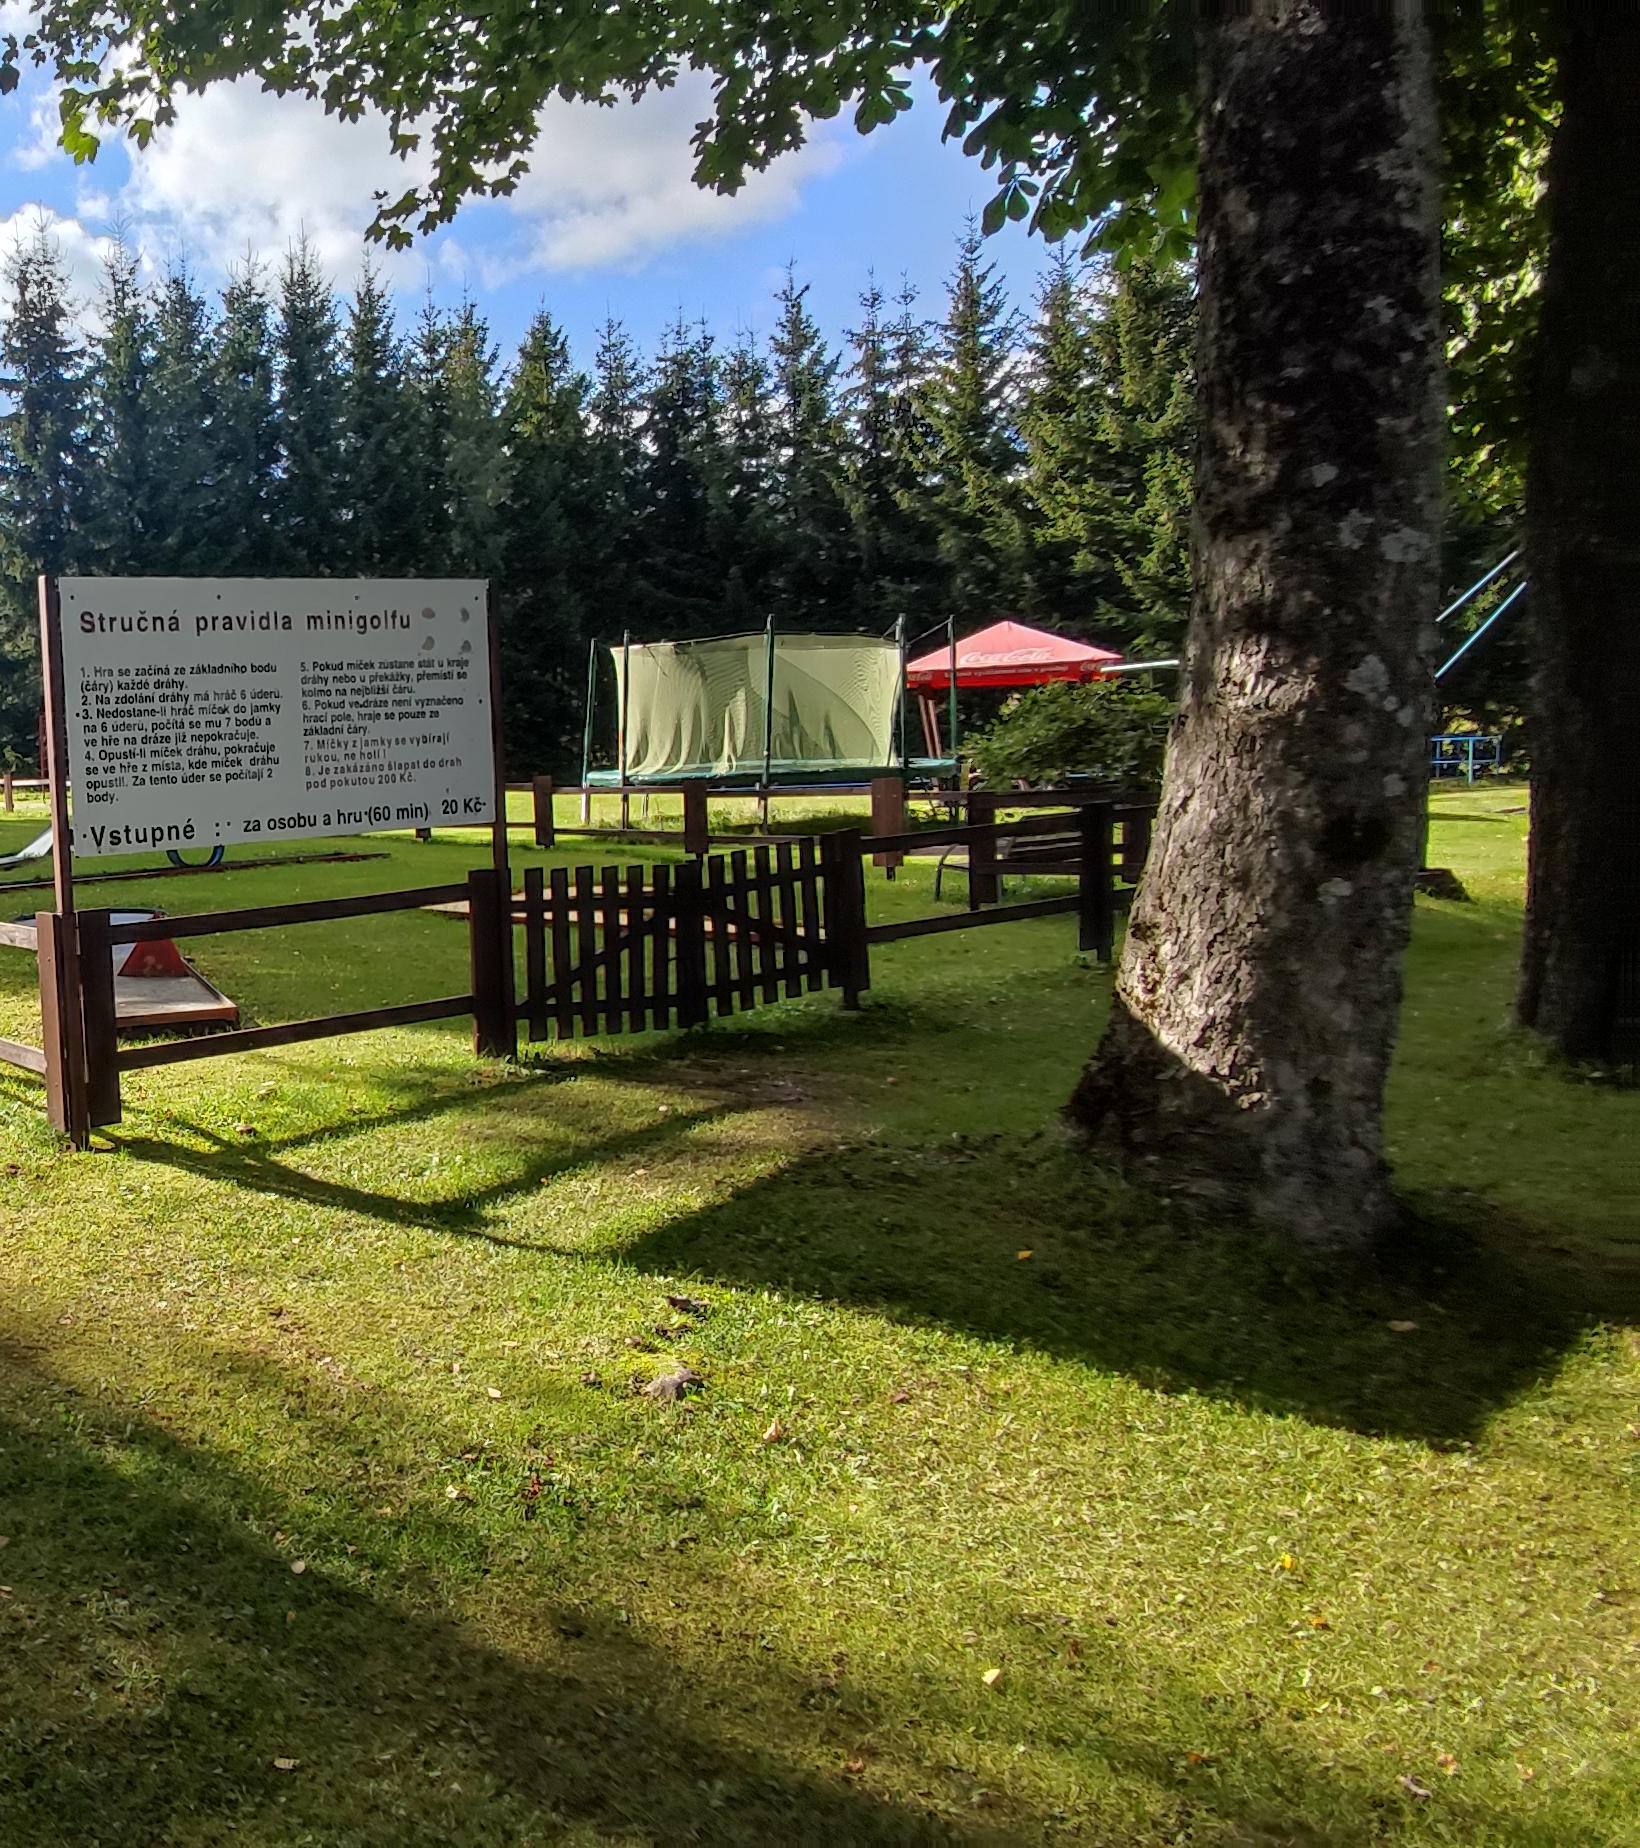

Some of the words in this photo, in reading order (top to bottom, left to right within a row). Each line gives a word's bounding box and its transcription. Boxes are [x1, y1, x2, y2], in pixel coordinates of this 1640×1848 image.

[80, 609, 180, 633] Stručná
[196, 610, 292, 637] pravidla
[306, 609, 410, 635] minigolfu
[94, 666, 114, 677] Hra
[118, 668, 131, 677] se
[135, 664, 170, 677] začíná
[174, 666, 186, 675] ze
[189, 663, 247, 675] základního
[251, 662, 277, 673] bodu
[300, 661, 310, 672] 5.
[312, 660, 344, 671] Pokud
[346, 659, 375, 670] míček
[438, 659, 444, 668] u
[447, 657, 469, 670] kraje
[81, 680, 113, 694] (čáry)
[117, 679, 150, 690] každé
[301, 674, 329, 686] dráhy
[332, 674, 357, 684] nebo
[360, 675, 366, 683] u
[457, 671, 467, 680] se
[96, 694, 110, 705] Na
[115, 692, 155, 704] zdolání
[158, 692, 189, 706] dráhy
[194, 690, 209, 701] má
[213, 689, 237, 701] hráč
[240, 689, 247, 700] 6
[302, 687, 332, 698] kolmo
[335, 689, 347, 697] na
[82, 708, 92, 720] 3.
[171, 705, 194, 716] hráč
[198, 703, 229, 715] míček
[233, 704, 247, 714] do
[250, 702, 281, 715] jamky
[302, 700, 311, 711] 6.
[314, 699, 346, 711] Pokud
[348, 701, 360, 710] ve
[414, 695, 464, 708] vyznačeno
[83, 724, 97, 733] na
[101, 722, 108, 732] 6
[151, 718, 185, 733] počítá
[189, 720, 201, 729] se
[205, 719, 222, 728] mu
[225, 717, 231, 727] 7
[265, 717, 272, 726] a
[303, 711, 328, 724] hrací
[357, 710, 382, 724] hraje
[384, 711, 396, 721] se
[398, 710, 427, 722] pouze
[429, 710, 440, 719] ze
[84, 738, 98, 747] ve
[101, 735, 120, 746] hře
[124, 736, 137, 745] na
[175, 732, 187, 745] již
[191, 729, 259, 744] nepokračuje.
[303, 724, 344, 736] základní
[150, 746, 182, 758] míček
[186, 745, 221, 756] dráhu,
[224, 741, 276, 757] pokračuje
[304, 740, 314, 751] 7.
[317, 738, 349, 750] Míčky
[352, 739, 358, 748] z
[360, 736, 392, 750] jamky
[394, 737, 407, 746] se
[409, 732, 450, 747] vybírají
[343, 752, 356, 761] ne
[85, 766, 99, 775] se
[103, 765, 116, 774] ve
[120, 762, 138, 773] hře
[142, 764, 148, 772] z
[188, 759, 208, 770] kde
[211, 757, 242, 768] míček
[249, 755, 280, 766] dráhu
[305, 766, 315, 777] 8.
[318, 764, 331, 776] Je
[333, 761, 385, 775] zakázáno
[422, 758, 436, 769] do
[132, 776, 146, 786] Za
[150, 774, 178, 785] tento
[181, 773, 206, 784] úder
[209, 773, 222, 782] se
[225, 768, 264, 783] počítají
[266, 768, 273, 778] 2
[306, 778, 327, 792] pod
[329, 776, 375, 790] pokutou
[377, 773, 397, 785] 200
[87, 792, 119, 804] body.
[90, 818, 195, 848] Vstupné
[243, 819, 261, 833] za
[267, 812, 317, 830] osobu
[323, 812, 332, 826] a
[337, 809, 362, 825] hru
[368, 805, 391, 826] (60
[396, 802, 429, 821] min)
[442, 799, 458, 815] 20
[464, 797, 482, 814] Kč
